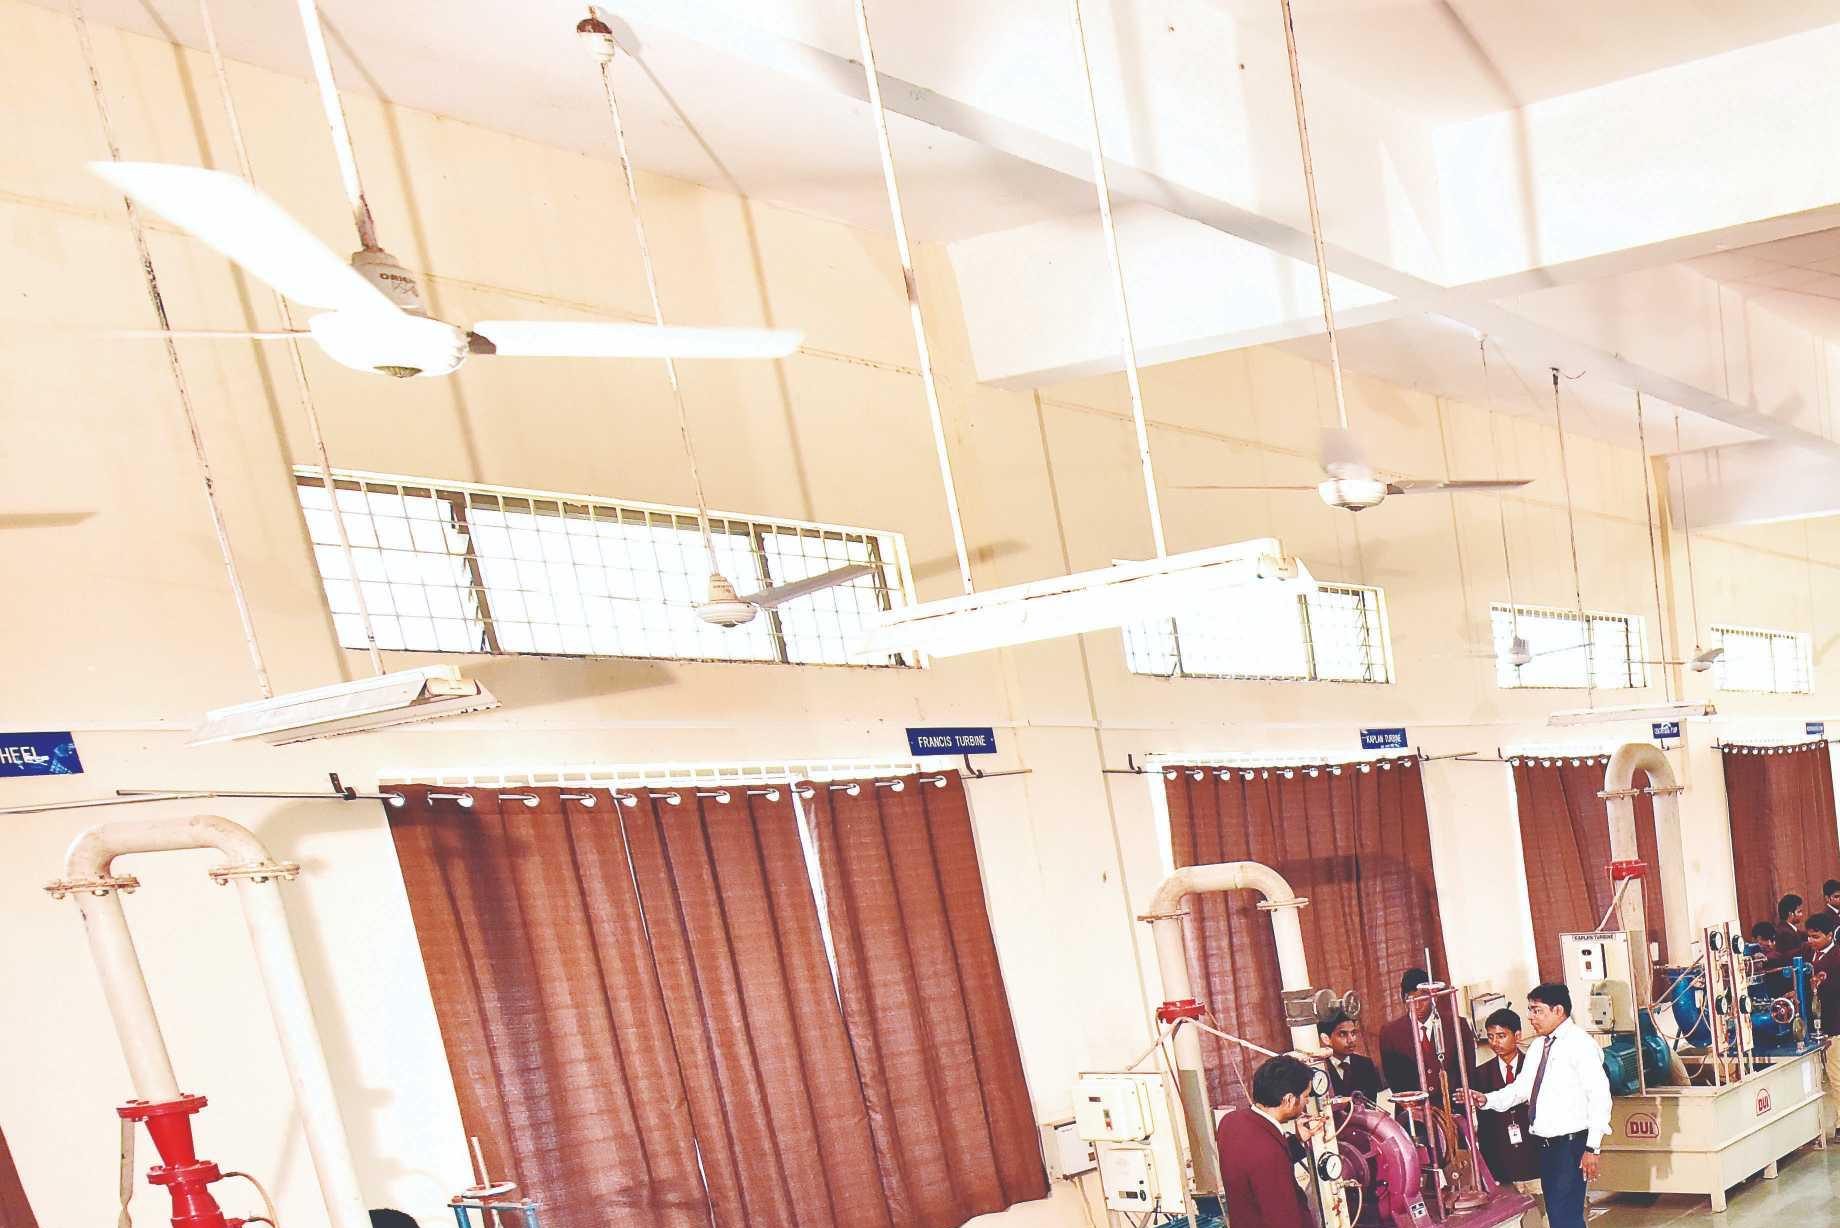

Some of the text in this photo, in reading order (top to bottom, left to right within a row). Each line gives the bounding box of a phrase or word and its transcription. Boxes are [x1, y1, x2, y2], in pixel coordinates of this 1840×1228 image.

[918, 735, 987, 748] FRANCIS TURBINE
[1629, 1121, 1655, 1135] DUI
